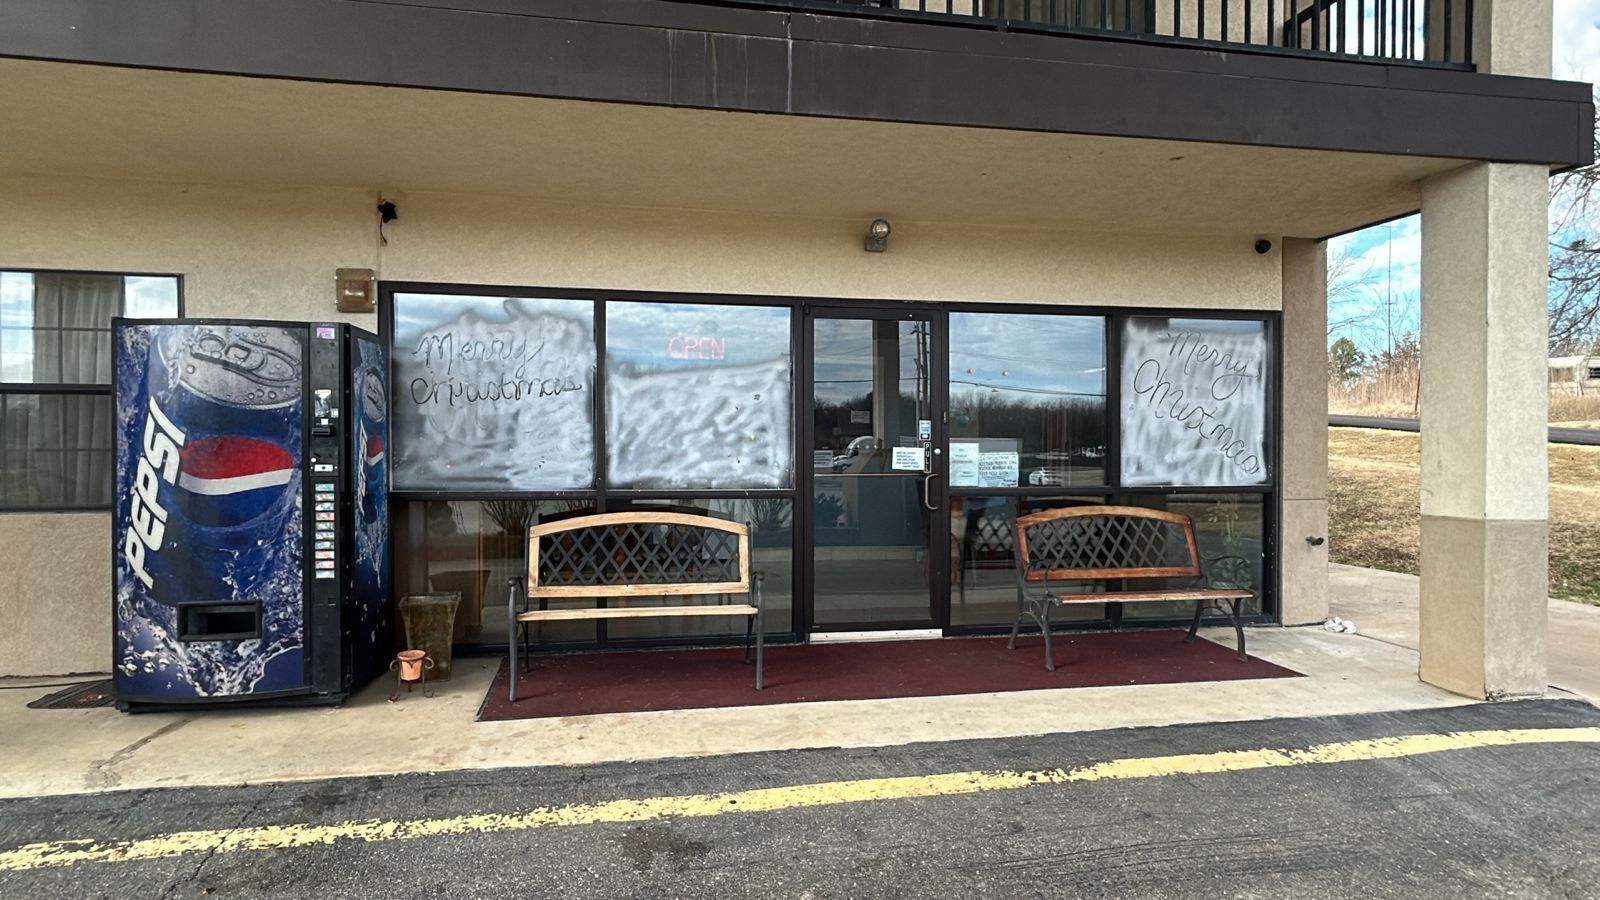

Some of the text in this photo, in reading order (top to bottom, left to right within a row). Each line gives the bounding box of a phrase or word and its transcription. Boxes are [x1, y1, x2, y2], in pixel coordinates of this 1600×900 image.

[412, 332, 545, 379] Merry
[668, 336, 725, 359] OPEN
[1167, 331, 1260, 401] Merry
[1134, 359, 1259, 474] Christmas
[125, 397, 186, 589] PEPSI
